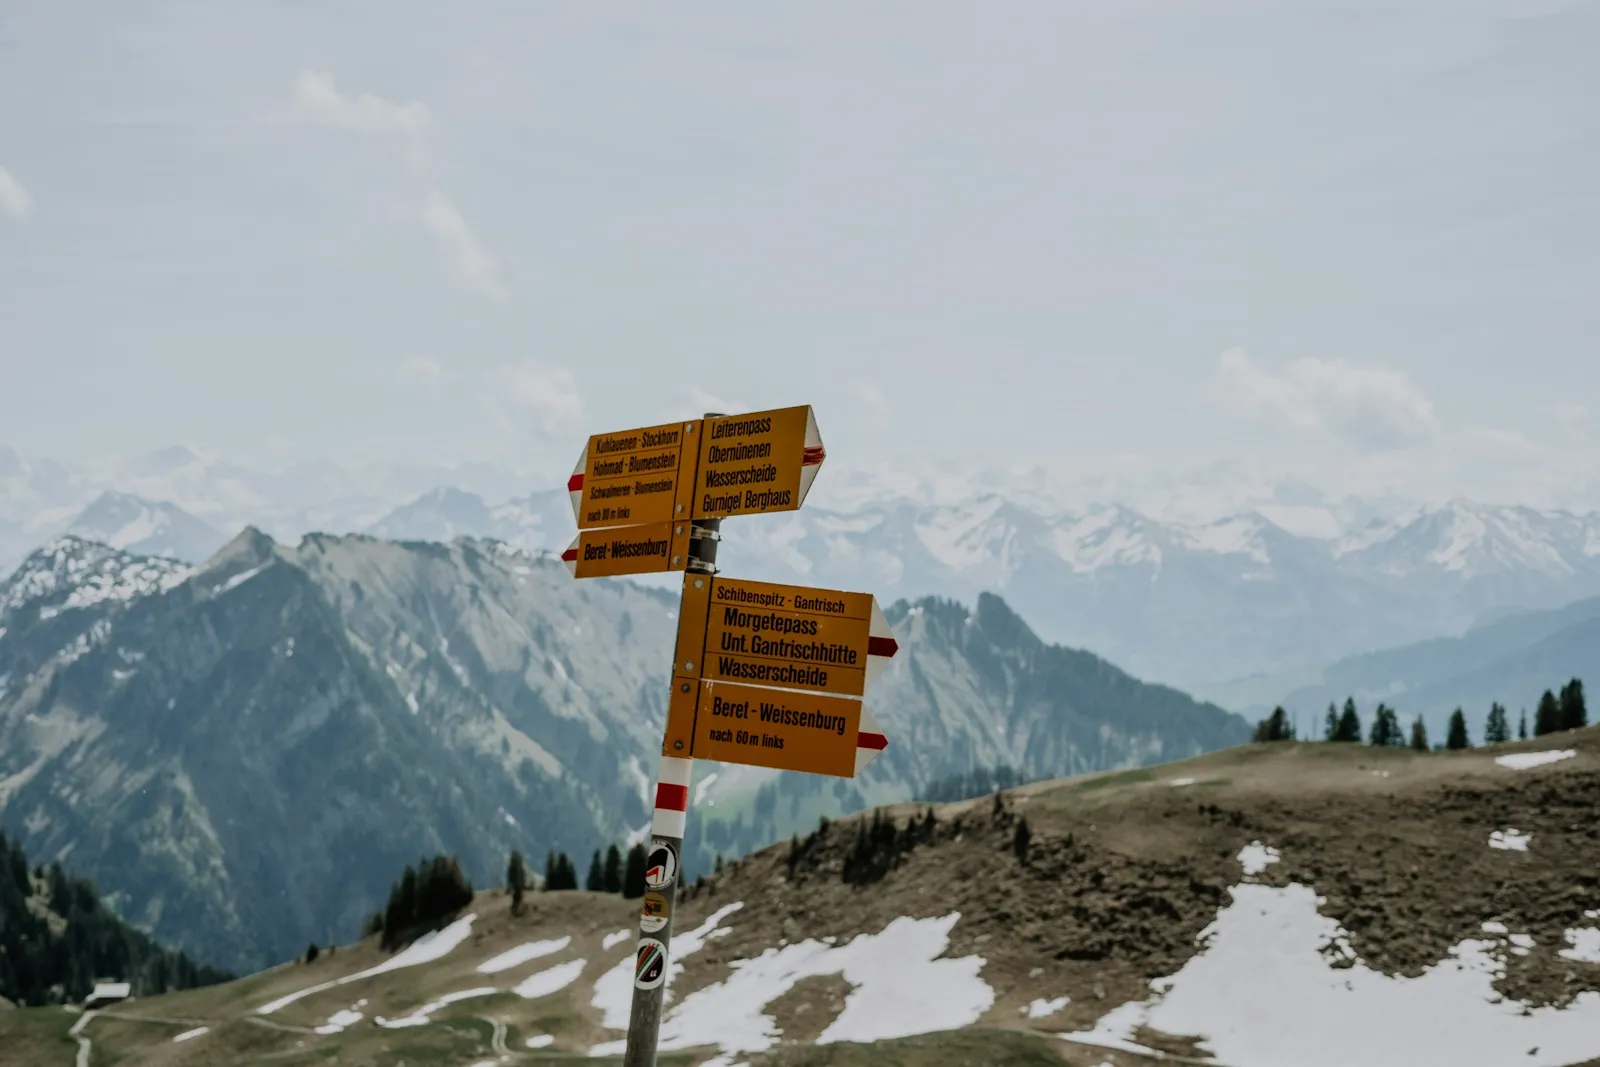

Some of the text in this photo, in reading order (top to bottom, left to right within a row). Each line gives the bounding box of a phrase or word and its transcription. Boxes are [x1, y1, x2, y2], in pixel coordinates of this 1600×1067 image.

[641, 430, 678, 448] Stockhorn
[711, 418, 771, 439] Leiterenpass
[628, 451, 676, 473] Blumenstein
[708, 442, 771, 463] Obernünenen
[634, 478, 673, 495] Blumenstein
[706, 463, 777, 488] Wasserscheide
[703, 488, 791, 513] Gurnigel Berghaus
[587, 508, 601, 522] nach
[584, 543, 607, 560] Beret
[611, 538, 668, 558] Weissenburg
[717, 585, 785, 607] Schibenspitz
[794, 595, 845, 613] Gantrisch
[723, 607, 818, 635] Morgetepass
[721, 632, 857, 665] Unt. Gantrischhütte
[719, 656, 828, 686] Wasserscheide
[712, 696, 749, 719] Beret
[760, 702, 846, 735] Weissenburg
[709, 729, 732, 743] nach
[761, 733, 784, 750] links
